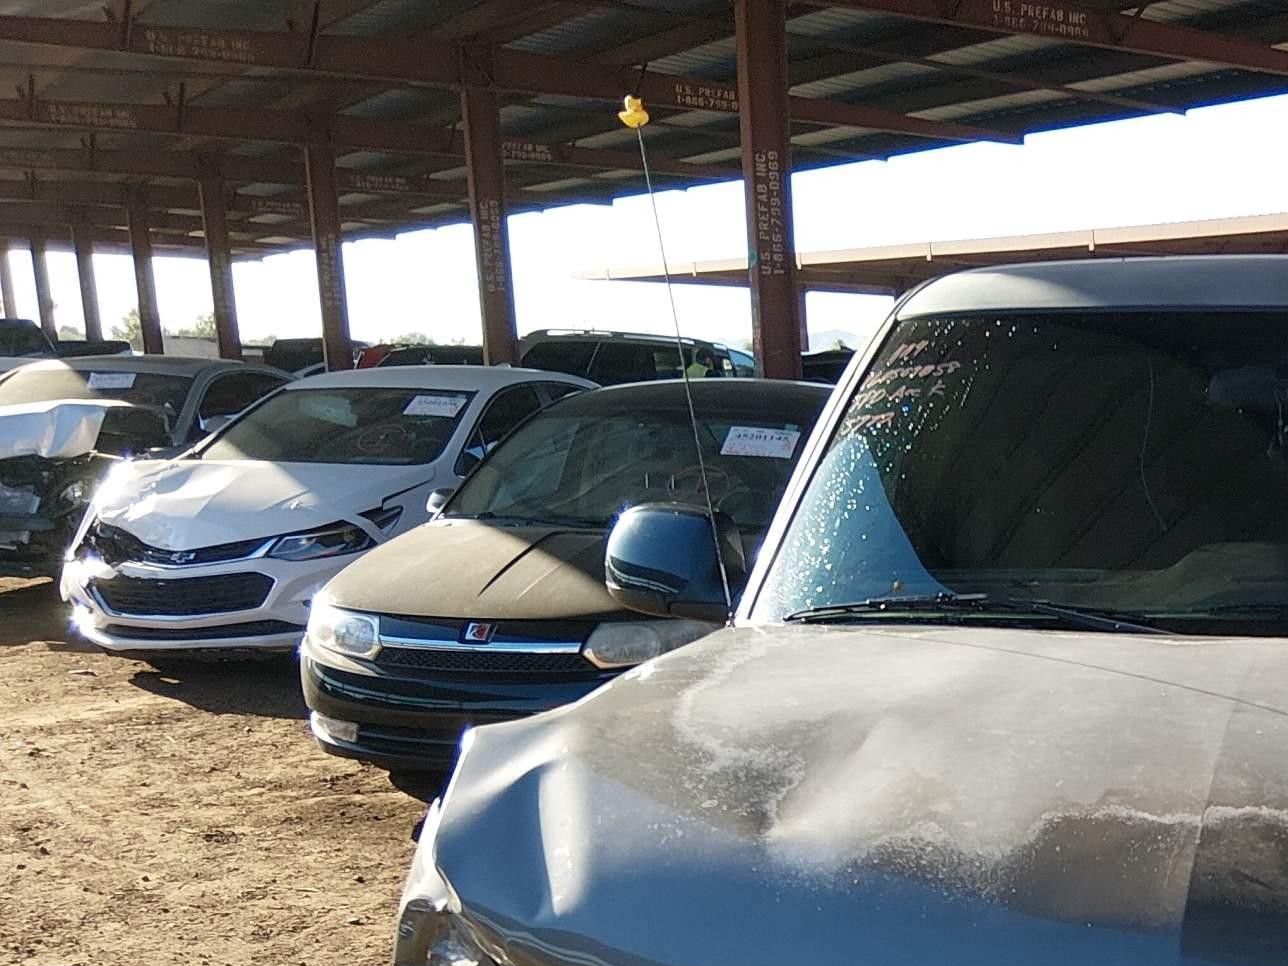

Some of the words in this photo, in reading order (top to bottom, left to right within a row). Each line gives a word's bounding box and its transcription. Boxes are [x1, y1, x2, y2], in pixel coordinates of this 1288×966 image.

[1020, 4, 1064, 22] PREFAB
[757, 184, 769, 240] PREFAB
[768, 150, 784, 275] 1-866-799-0969
